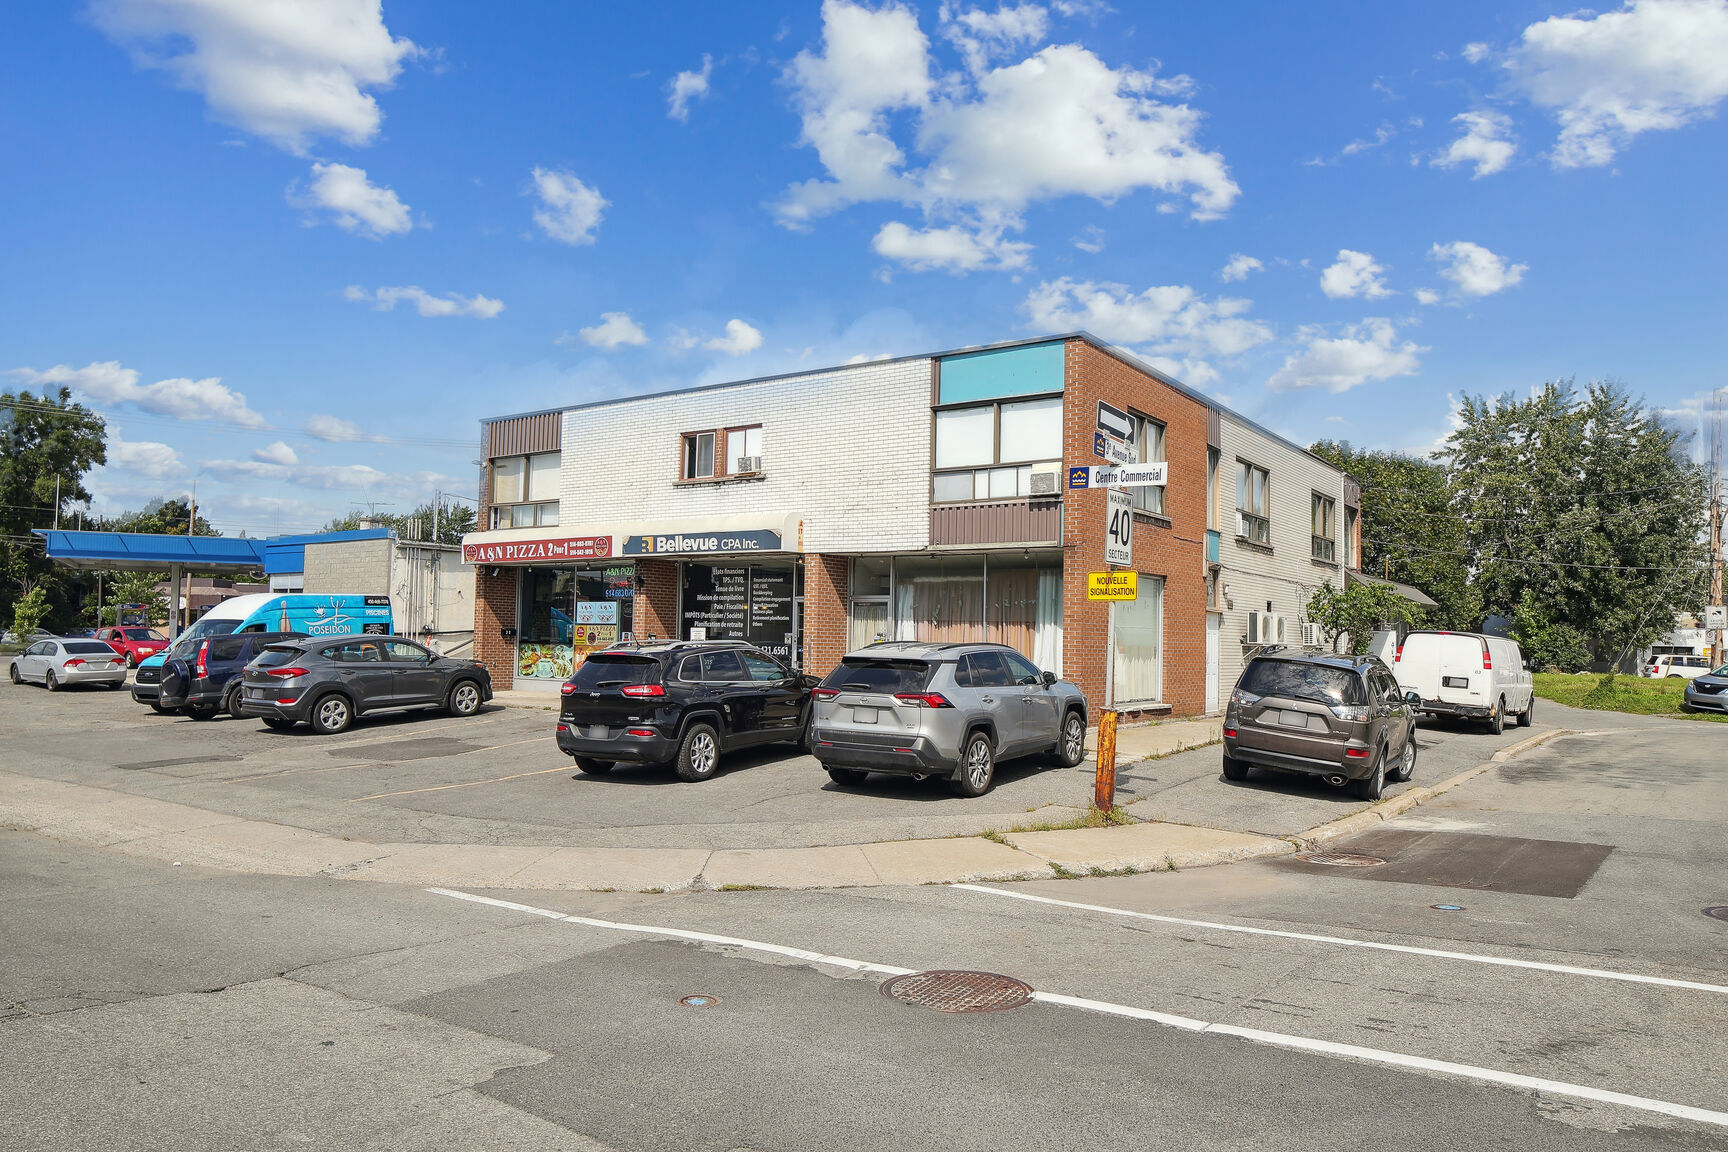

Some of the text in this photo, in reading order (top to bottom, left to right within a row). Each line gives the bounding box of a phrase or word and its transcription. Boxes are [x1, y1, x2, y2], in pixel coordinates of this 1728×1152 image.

[1112, 445, 1127, 462] Avenue
[1128, 451, 1136, 464] Sud
[1095, 468, 1162, 484] Centre Commercial
[1109, 493, 1132, 507] MAXIMUM
[1109, 508, 1130, 547] 40
[656, 536, 759, 553] Bellevue CPA Inc.
[478, 545, 503, 562] A&N
[506, 543, 546, 558] PIZZA
[548, 543, 553, 556] 2
[564, 542, 568, 555] 1
[1108, 548, 1129, 561] SECTEUR
[1096, 576, 1128, 585] NOUVELLE
[719, 594, 744, 602] compilation
[1090, 587, 1135, 596] SIGNALISATION
[308, 625, 351, 635] POSEIDON
[694, 620, 720, 628] Planification
